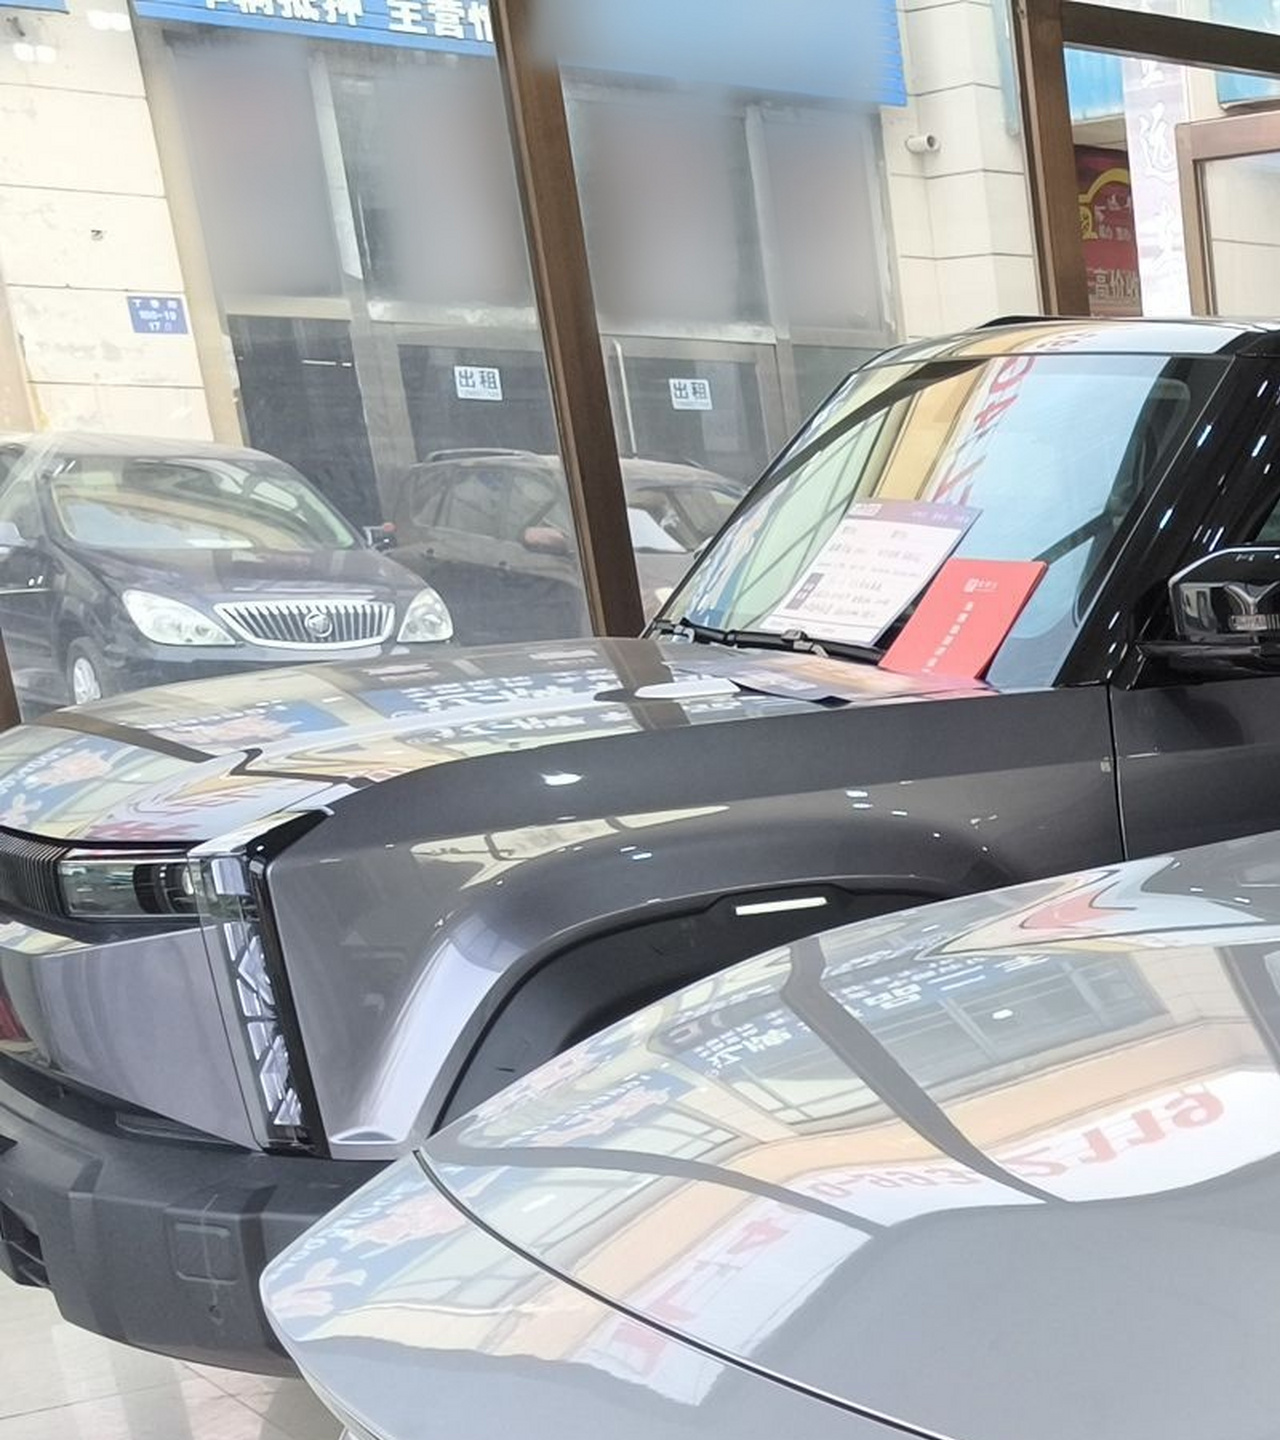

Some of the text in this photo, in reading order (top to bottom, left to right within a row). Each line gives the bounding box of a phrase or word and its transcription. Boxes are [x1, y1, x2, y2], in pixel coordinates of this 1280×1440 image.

[205, 0, 364, 26] 抵押
[458, 369, 498, 390] 出租
[673, 382, 709, 400] 出租
